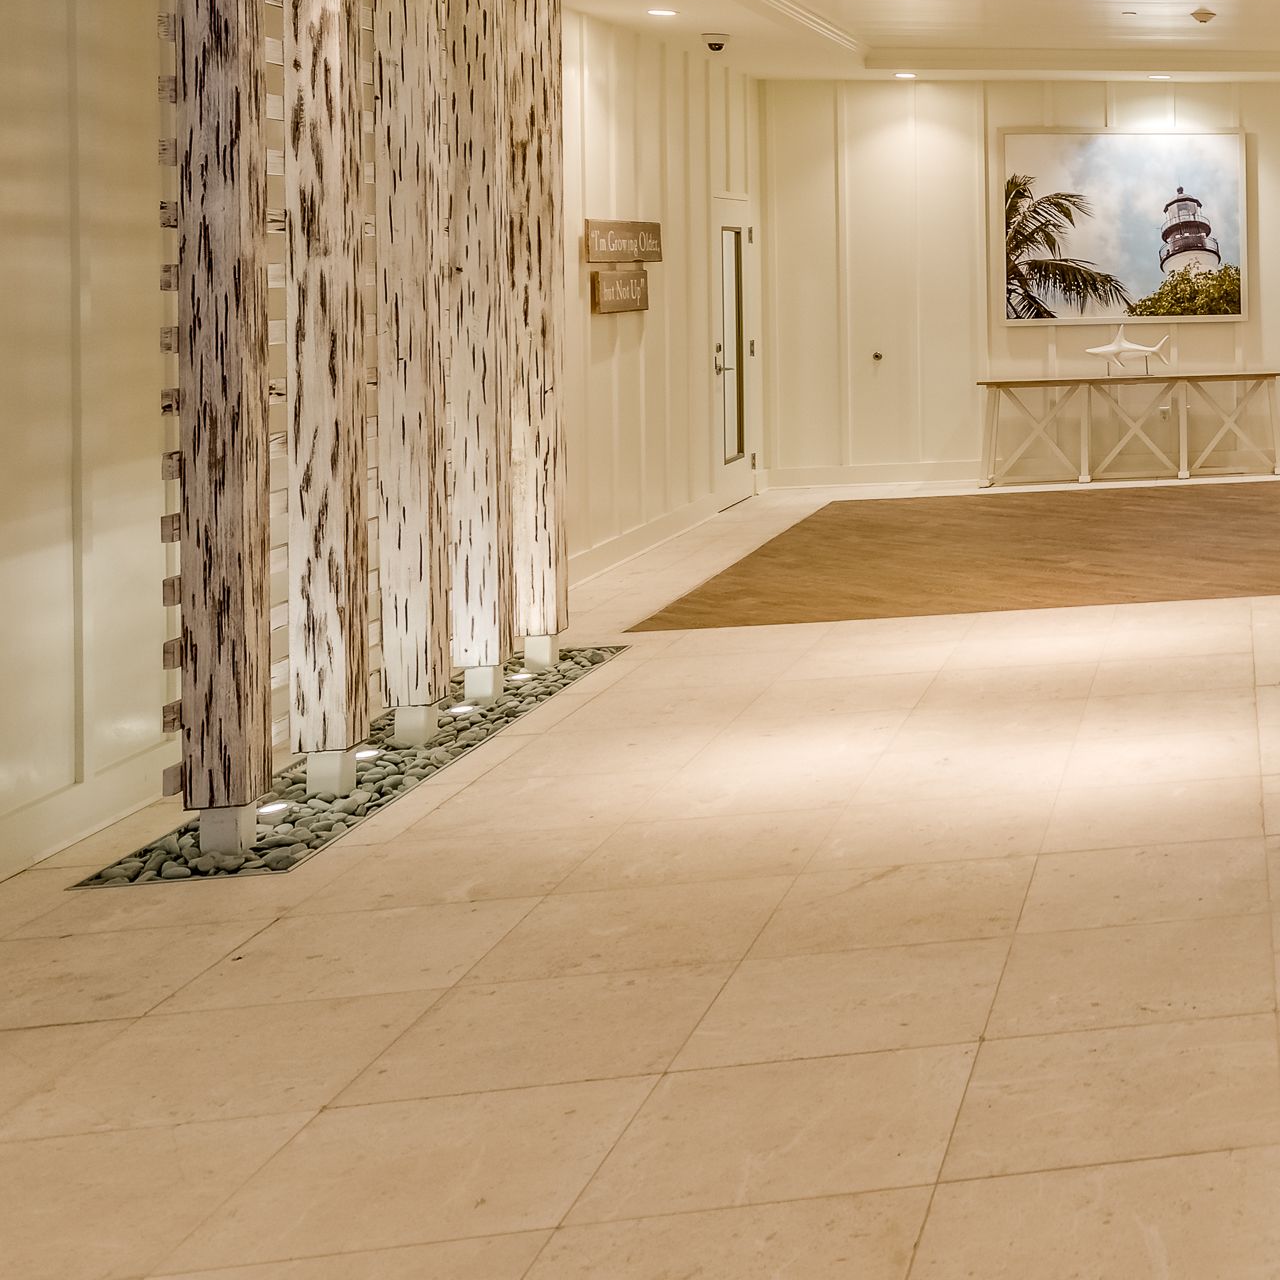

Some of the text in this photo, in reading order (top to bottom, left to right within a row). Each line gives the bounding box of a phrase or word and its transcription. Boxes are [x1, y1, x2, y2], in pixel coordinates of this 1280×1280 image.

[608, 230, 638, 257] Growing
[603, 281, 615, 301] but
[616, 279, 630, 300] Not
